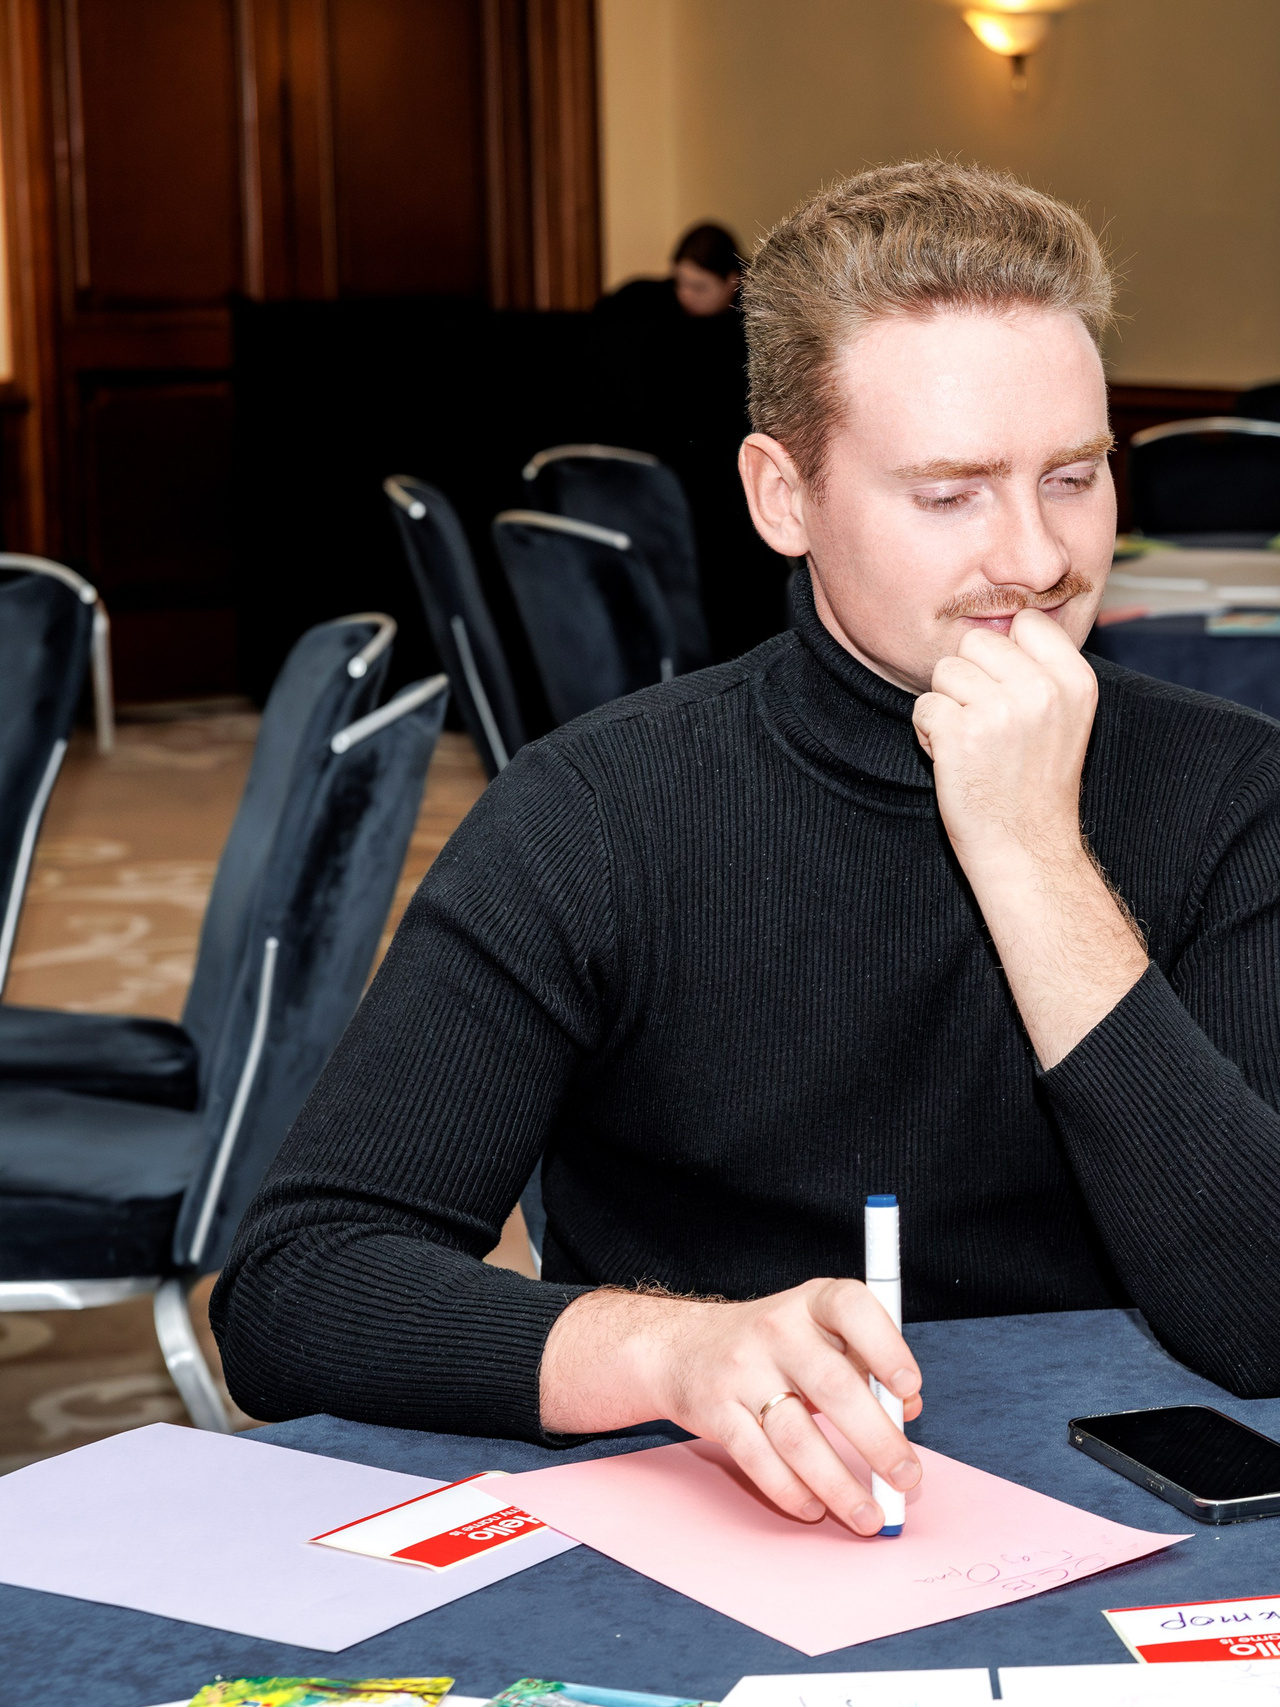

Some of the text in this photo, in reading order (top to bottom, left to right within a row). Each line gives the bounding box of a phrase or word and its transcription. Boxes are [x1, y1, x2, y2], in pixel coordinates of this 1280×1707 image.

[461, 1515, 501, 1532] name
[448, 1529, 465, 1538] is
[1219, 1636, 1234, 1646] is
